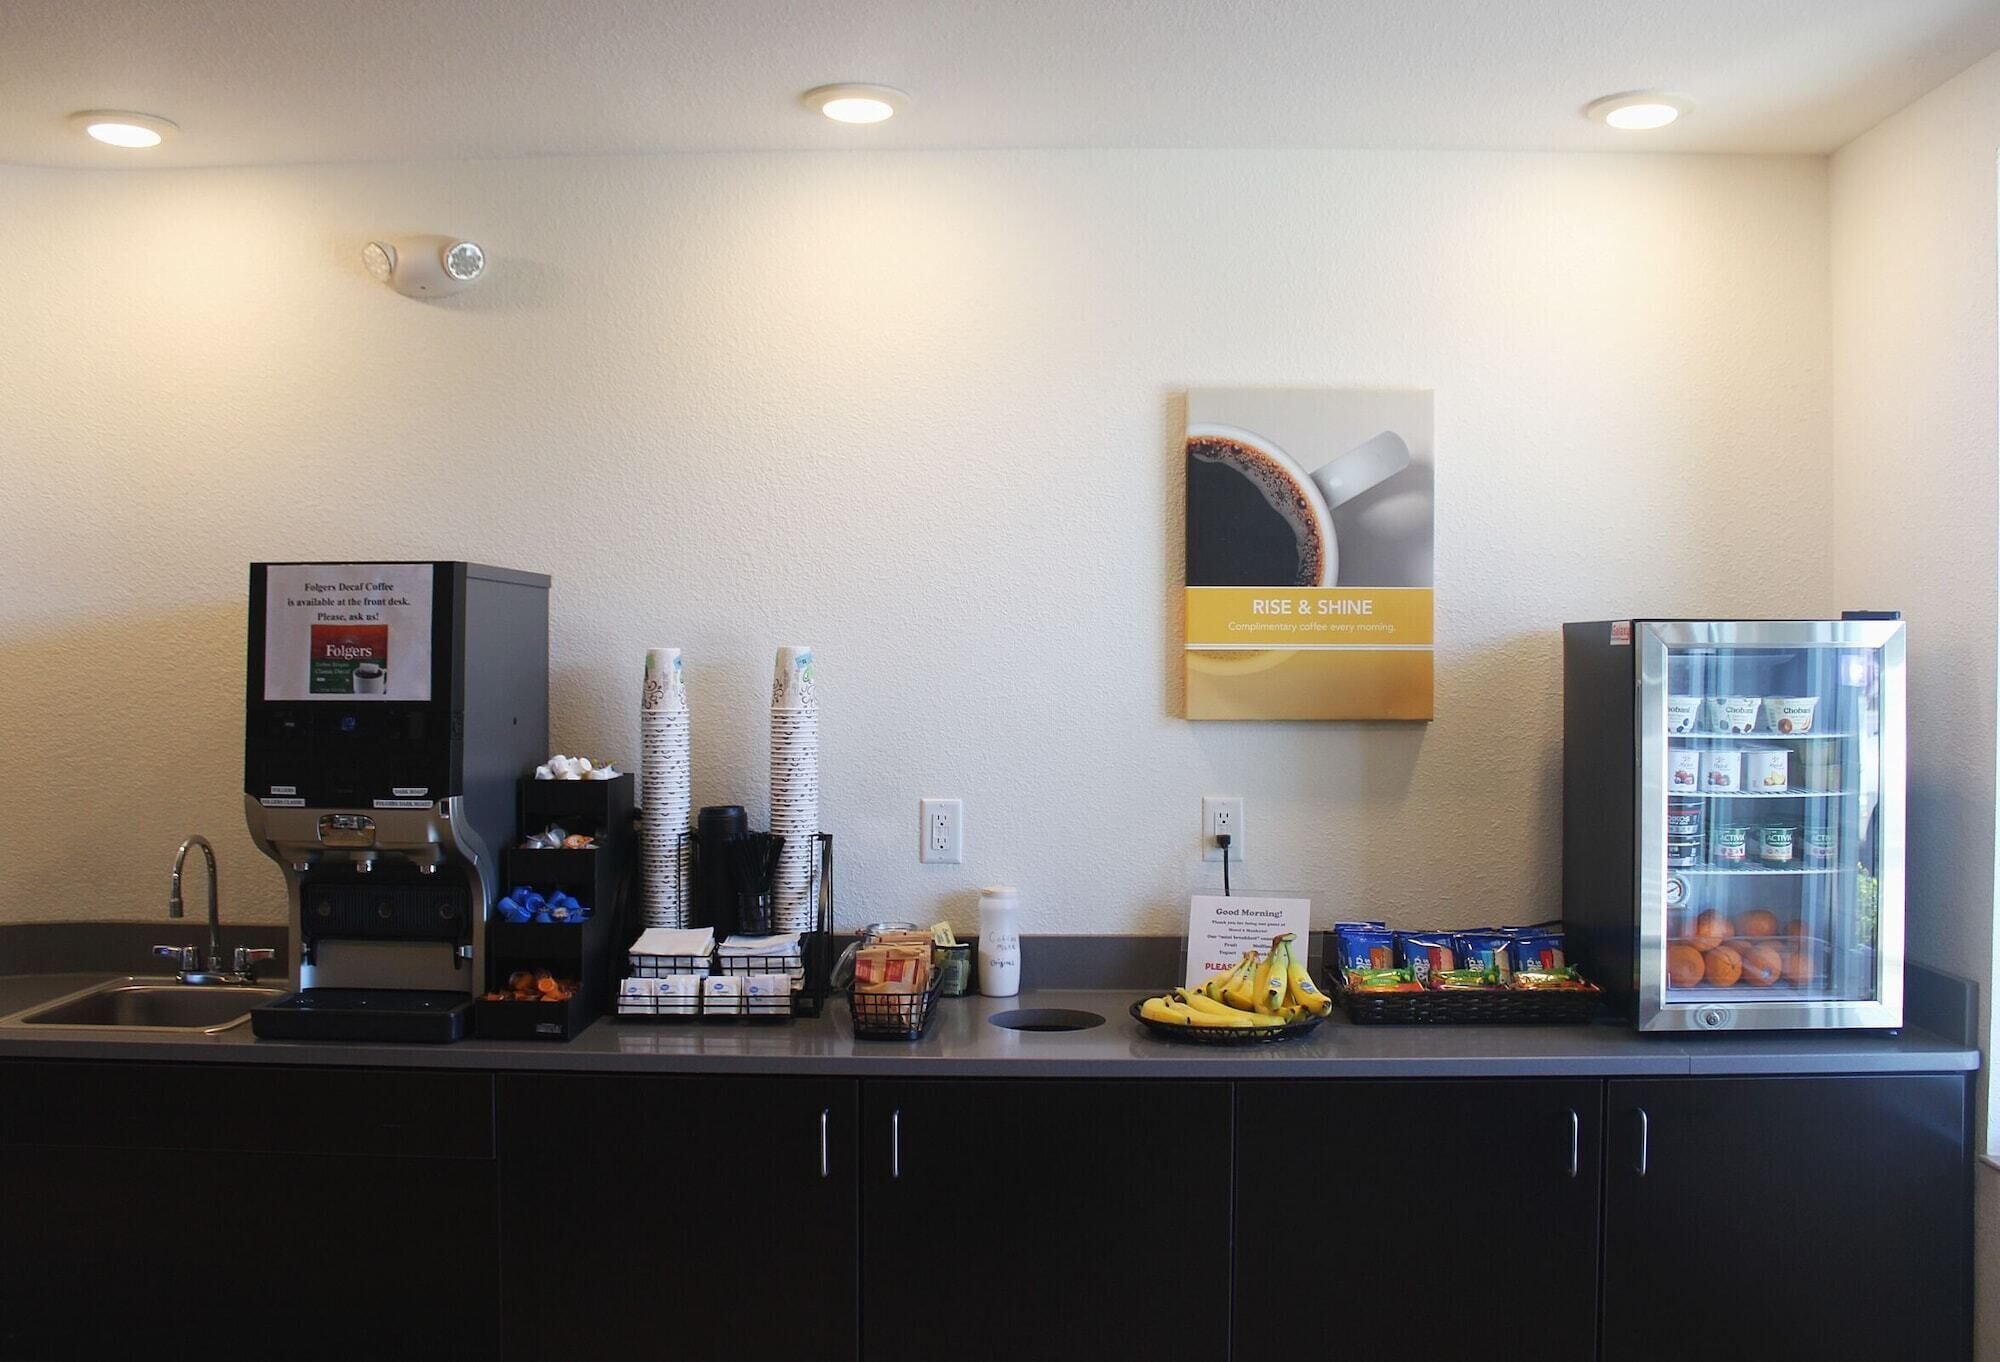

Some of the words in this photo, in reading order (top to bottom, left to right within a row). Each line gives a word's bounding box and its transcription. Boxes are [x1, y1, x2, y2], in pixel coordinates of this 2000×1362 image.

[304, 583, 336, 593] Folgers
[339, 582, 363, 591] Decaf
[365, 582, 394, 591] Coffee
[287, 598, 295, 606] is
[296, 598, 335, 606] available
[337, 598, 346, 606] at
[348, 598, 361, 606] the
[363, 598, 386, 606] front
[387, 597, 411, 606] desk.
[1253, 599, 1292, 615] RISE
[1298, 599, 1311, 615] &
[1317, 599, 1373, 615] SHINE
[317, 612, 347, 621] Please,
[349, 612, 365, 621] ask
[366, 612, 380, 621] us!
[1228, 621, 1297, 633] Complimentary
[1299, 621, 1328, 632] coffee
[1330, 623, 1355, 633] every
[1356, 622, 1396, 633] morning.
[326, 644, 373, 660] Folgers
[1215, 908, 1240, 916] Good
[1241, 908, 1283, 918] Morning!
[1205, 963, 1236, 971] PLEAS
